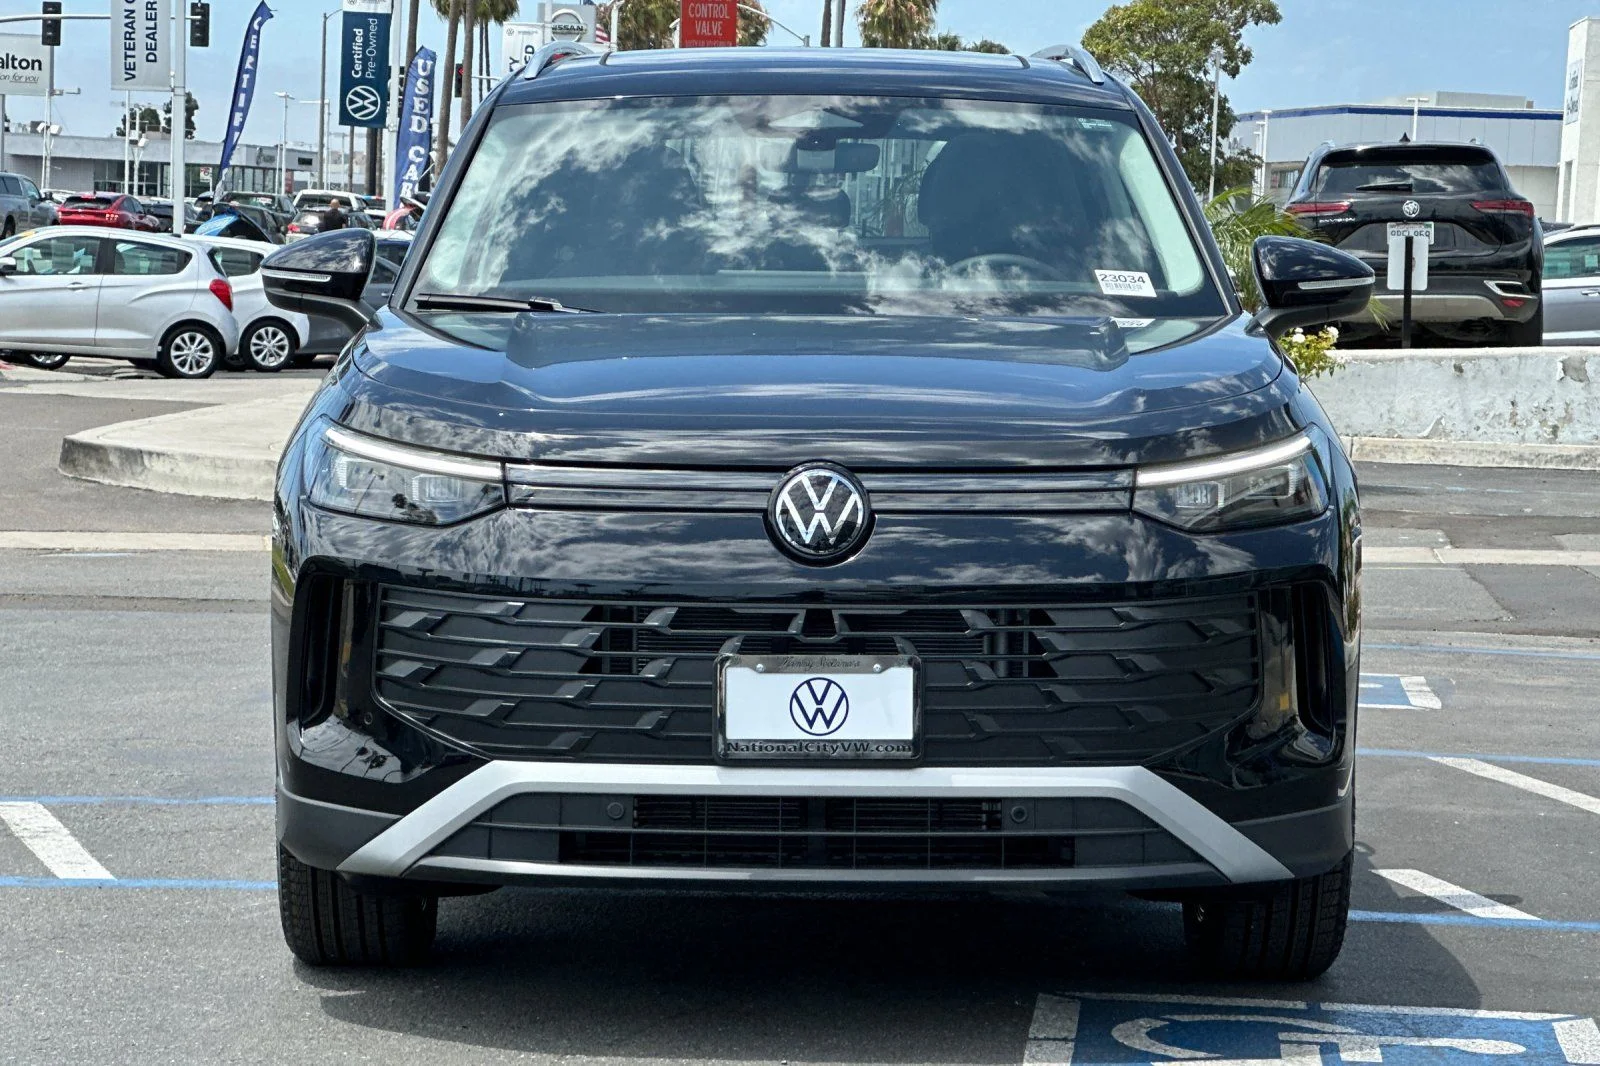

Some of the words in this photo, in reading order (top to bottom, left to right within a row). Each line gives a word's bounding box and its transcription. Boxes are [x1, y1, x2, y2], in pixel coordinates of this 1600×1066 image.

[688, 3, 730, 19] CONTROL
[695, 20, 723, 36] VALVE
[124, 8, 136, 82] VETERAN
[351, 28, 363, 78] Certified
[365, 18, 378, 79] Pre-Owned
[409, 58, 434, 134] USED
[1100, 274, 1146, 284] 23034
[727, 741, 912, 755] NationalCityVW.com
